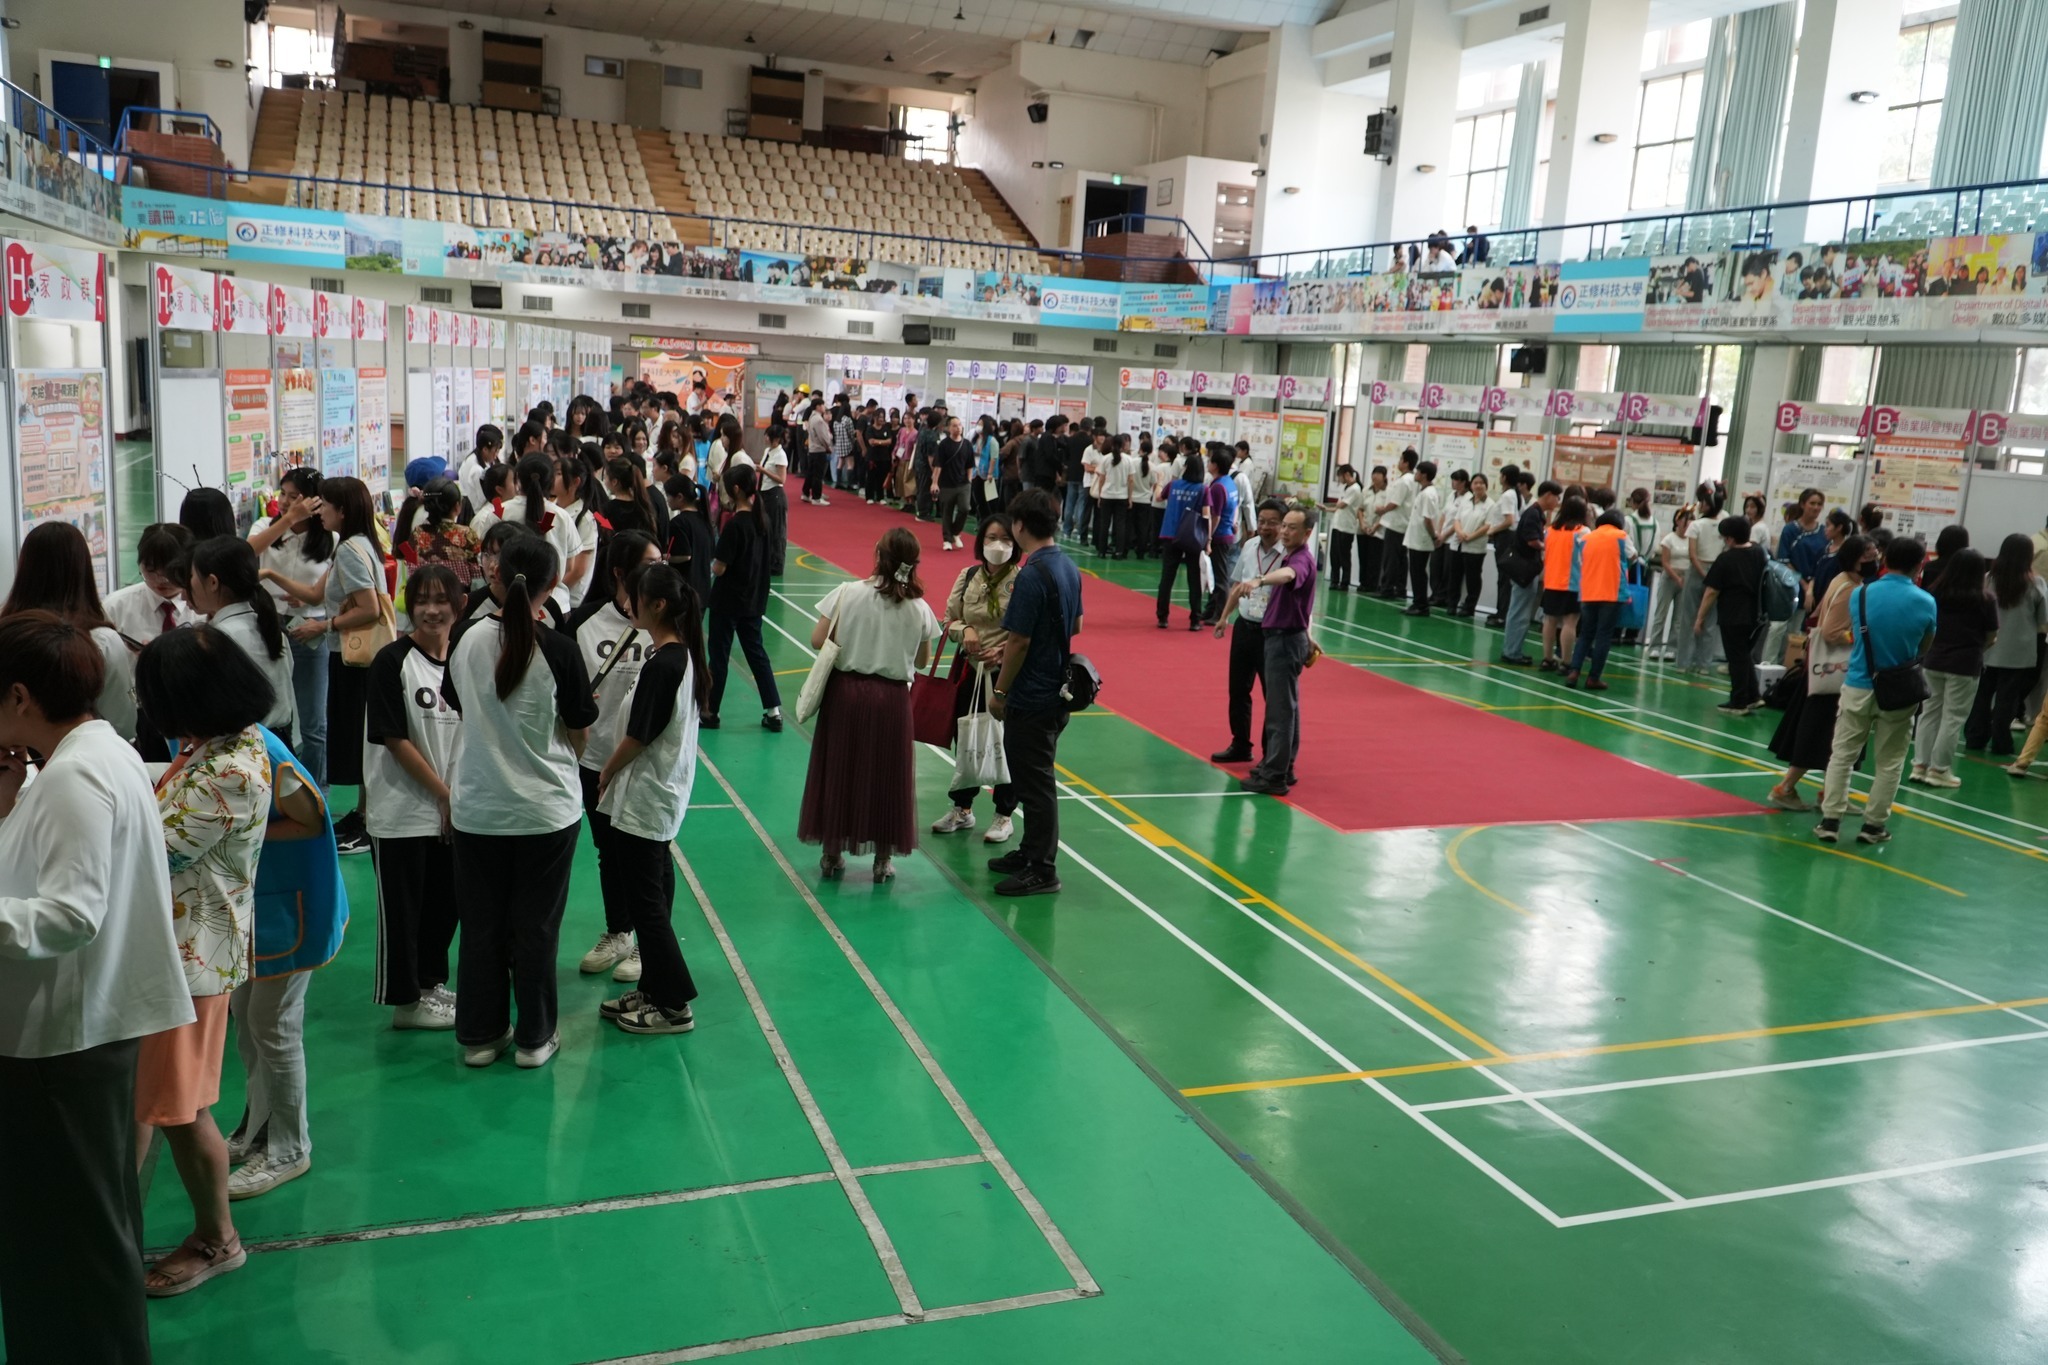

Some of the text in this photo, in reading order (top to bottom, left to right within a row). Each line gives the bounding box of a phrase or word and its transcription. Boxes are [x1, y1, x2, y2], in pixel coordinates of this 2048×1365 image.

[261, 223, 341, 241] 正修科技大學
[10, 256, 103, 315] H 家政群 7
[1579, 282, 1643, 298] 正修科技大學
[158, 278, 169, 315] H
[223, 288, 232, 321] H
[1061, 293, 1118, 308] 正修科技大學
[1954, 299, 2002, 311] Department
[2014, 298, 2042, 311] Digital
[1952, 311, 2048, 326] Design 數位多媒
[1373, 385, 1383, 400] R
[1430, 388, 1439, 405] R
[1490, 392, 1502, 409] R
[1558, 396, 1569, 412] R
[1631, 399, 1643, 417] R
[1781, 407, 1795, 427] B
[1876, 412, 1892, 433] B
[1899, 418, 1965, 434] 商業與管理群
[1982, 418, 1998, 440] B
